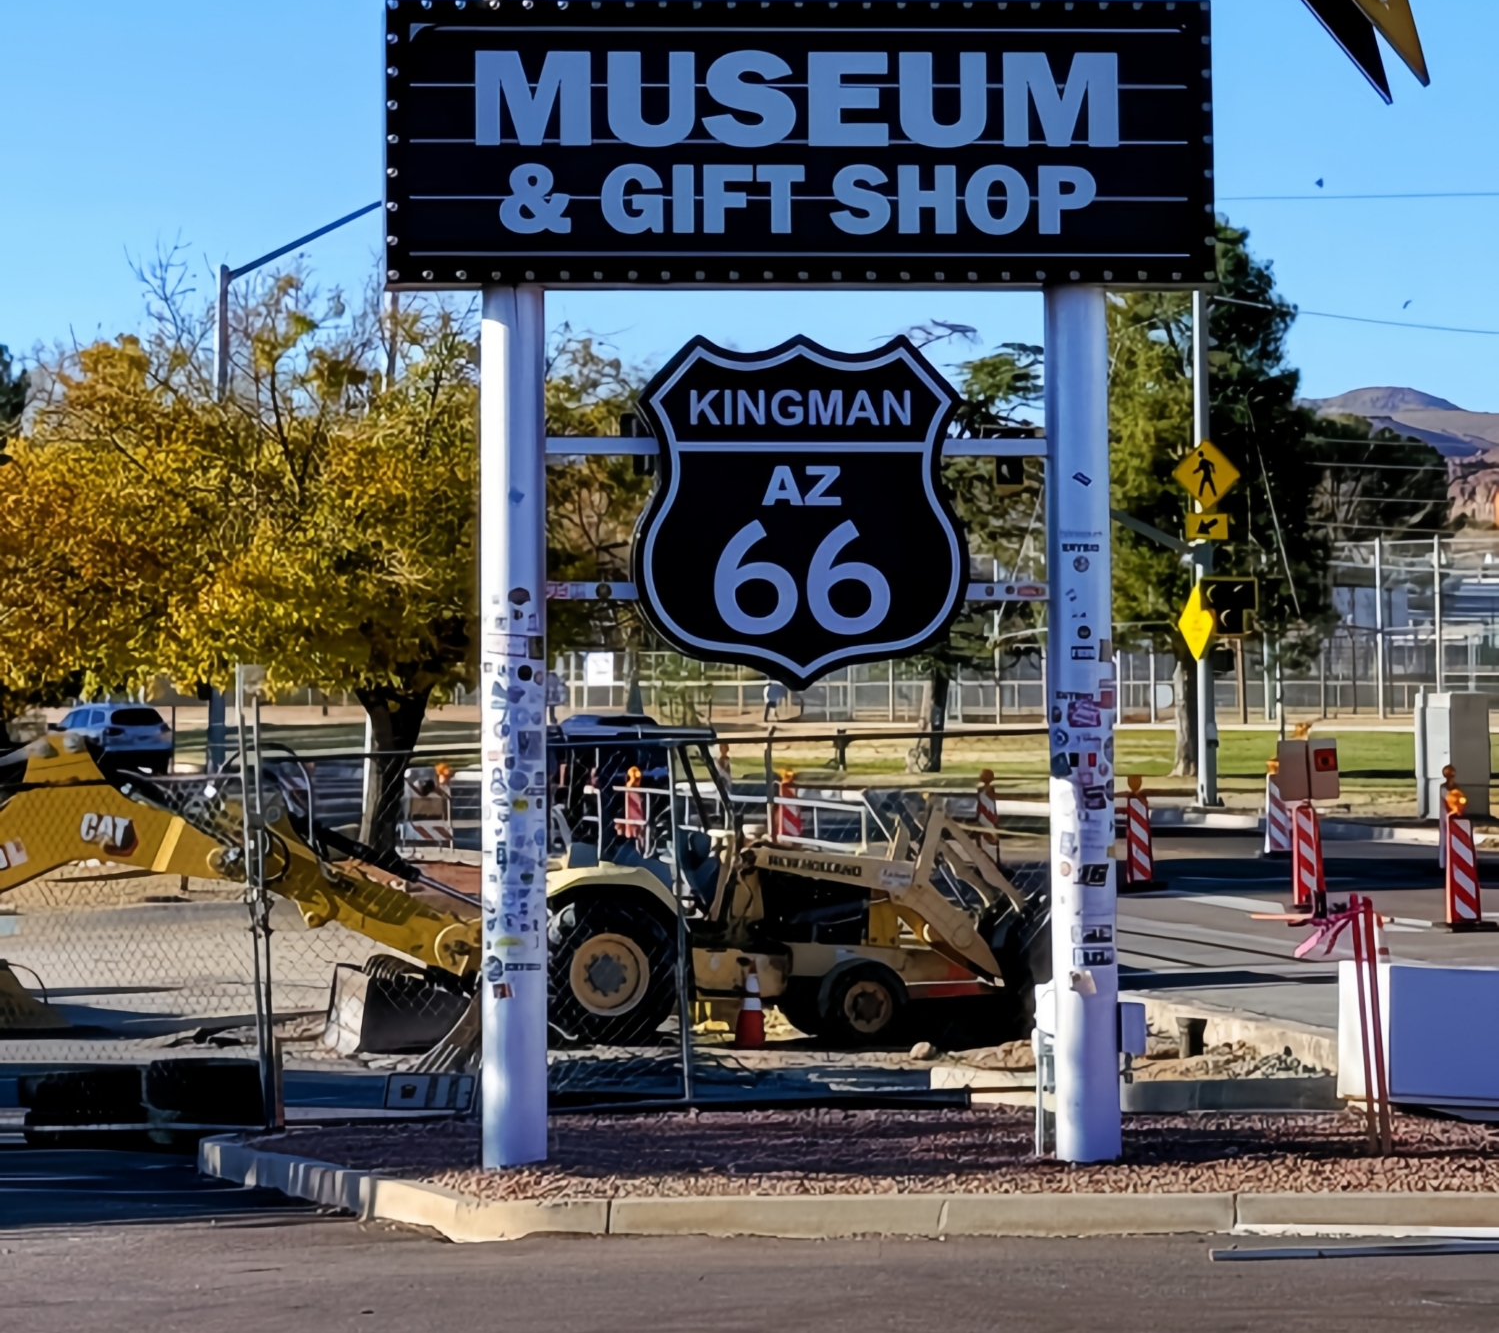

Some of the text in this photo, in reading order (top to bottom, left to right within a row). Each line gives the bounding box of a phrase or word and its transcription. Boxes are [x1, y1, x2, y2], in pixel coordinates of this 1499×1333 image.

[475, 50, 1120, 148] MUSEUM
[498, 163, 1097, 235] & GIFT SHOP
[690, 389, 911, 426] KINGMAN
[761, 465, 842, 506] AZ
[713, 519, 891, 635] 66
[80, 812, 131, 848] CAT
